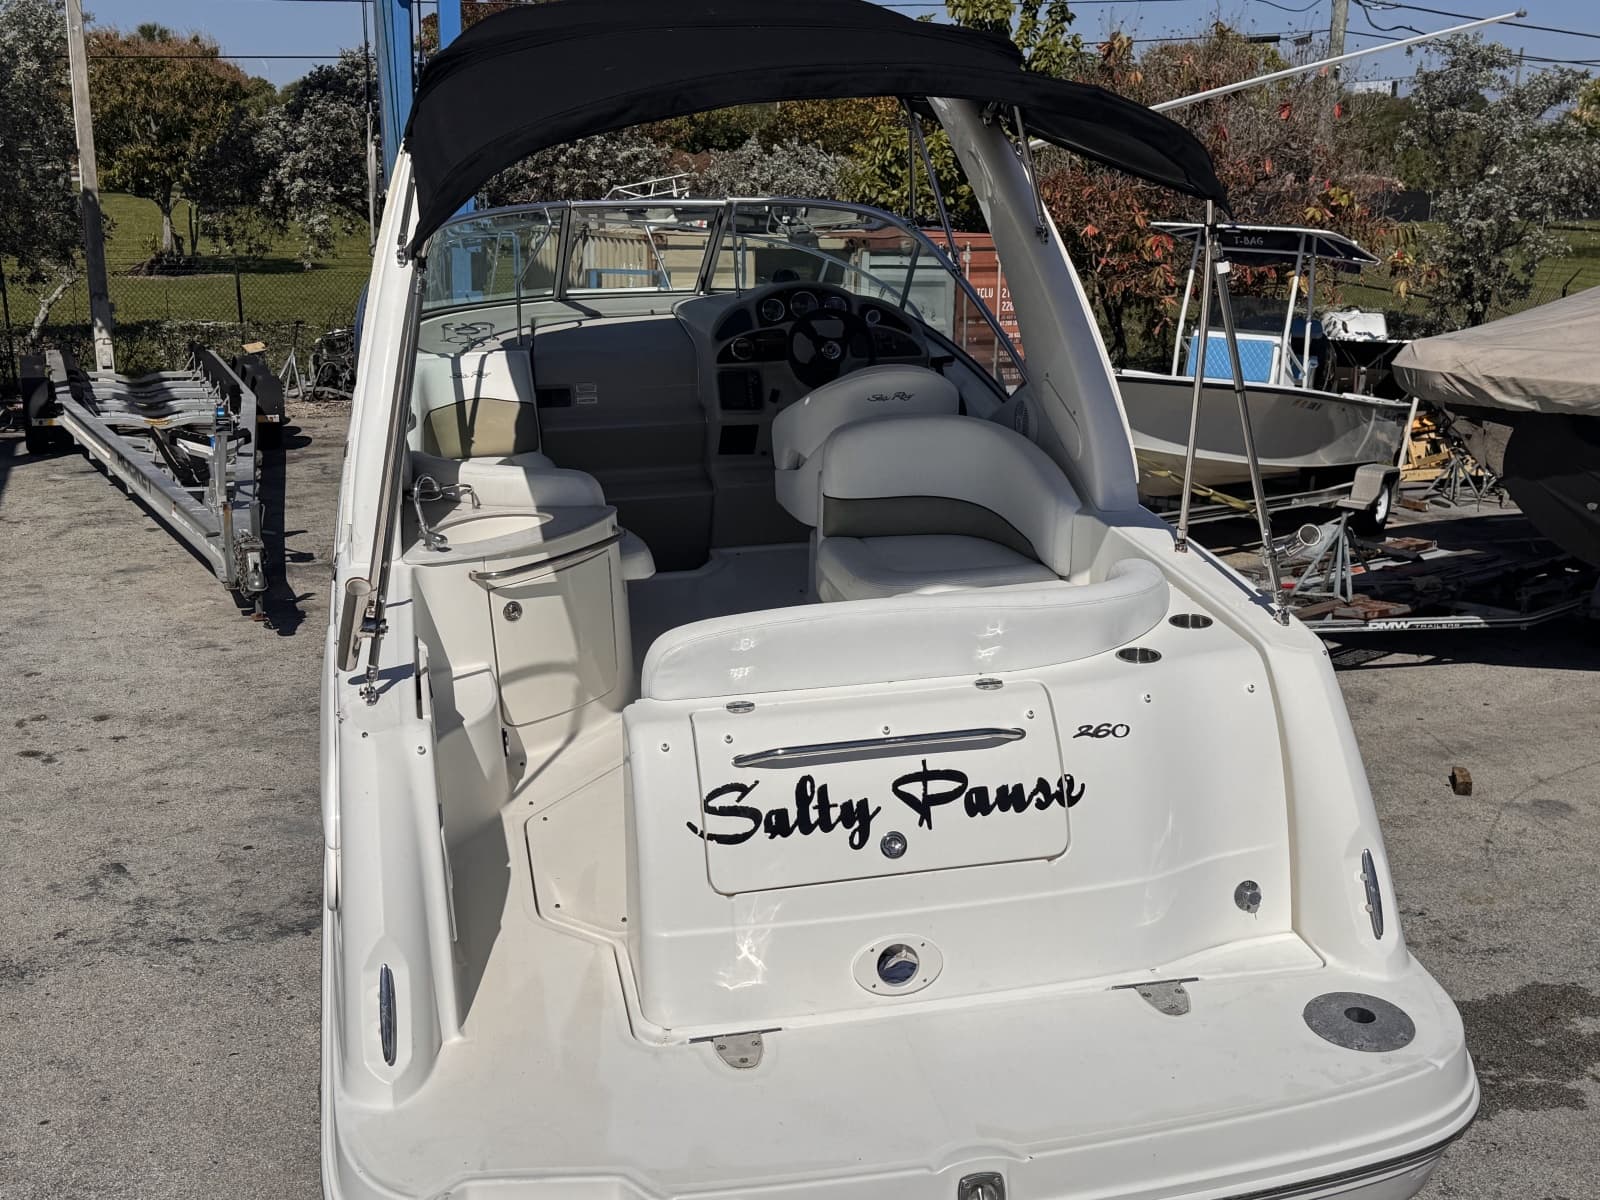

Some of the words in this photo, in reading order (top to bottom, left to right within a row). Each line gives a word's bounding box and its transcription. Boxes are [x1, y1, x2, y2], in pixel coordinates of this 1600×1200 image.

[1234, 236, 1264, 246] T-BAG
[976, 287, 994, 298] TCLU
[867, 393, 890, 402] Sea
[890, 391, 915, 402] Ray
[1368, 621, 1410, 630] DMW
[1072, 723, 1130, 739] 260
[686, 774, 882, 850] Salty
[892, 759, 1086, 830] Pause
